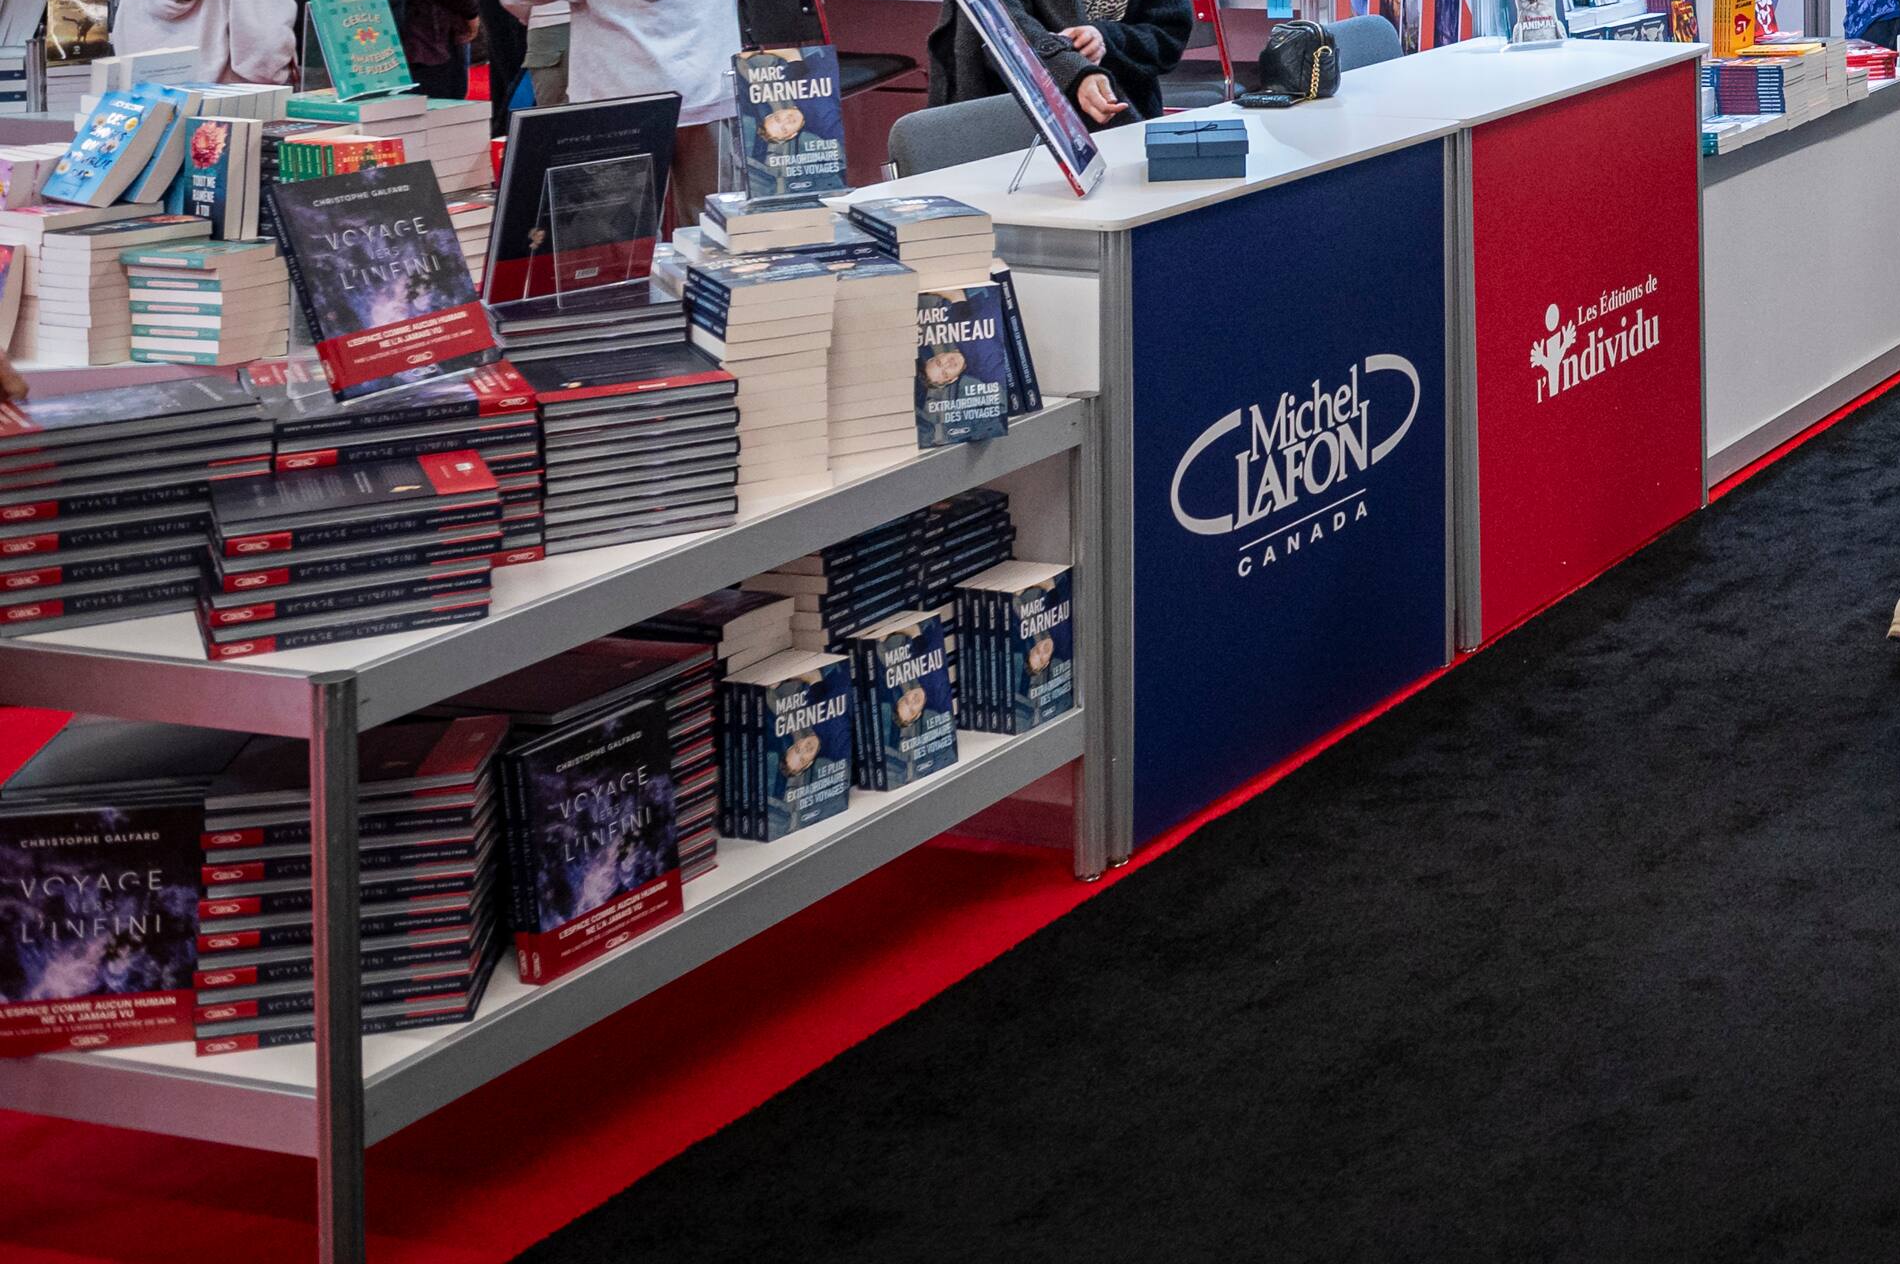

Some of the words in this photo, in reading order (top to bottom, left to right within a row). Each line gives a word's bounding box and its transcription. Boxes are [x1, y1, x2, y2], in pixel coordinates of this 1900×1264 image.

[1522, 21, 1556, 30] ANIMAL
[748, 65, 786, 83] MARC
[749, 77, 832, 104] GARNEAU
[804, 141, 816, 152] LE
[817, 138, 838, 150] PLUS
[769, 150, 840, 167] EXTRAORDINAIRE
[785, 165, 803, 177] DES
[804, 161, 840, 175] VOYAGES
[192, 175, 206, 187] TOUT
[206, 176, 216, 189] ME
[313, 192, 370, 207] CHRISTOPHE
[371, 184, 410, 198] GALFARD
[325, 216, 430, 250] VOYAGE
[339, 255, 442, 290] L'INFINI
[1577, 305, 1598, 326] Les
[1599, 289, 1643, 317] Éditions
[1645, 273, 1658, 294] de
[347, 330, 382, 348] L'ESPACE
[382, 324, 411, 339] COMME
[411, 318, 436, 333] AUCUN
[436, 310, 468, 326] HUMAIN
[964, 385, 977, 396] LE
[977, 382, 999, 394] PLUS
[928, 394, 1000, 413] EXTRAORDINAIRE
[944, 410, 963, 423] DES
[963, 405, 1000, 420] VOYAGES
[1249, 363, 1360, 463] Michel
[1233, 399, 1370, 530] LAFON
[1237, 501, 1368, 577] CANADA
[1020, 597, 1046, 618] MARC
[1020, 600, 1070, 639] GARNEAU
[885, 644, 912, 667] MARC
[886, 647, 944, 689] GARNEAU
[775, 689, 809, 712] MARC
[775, 693, 848, 738] GARNEAU
[926, 718, 936, 730] LE
[556, 747, 607, 773] CHRISTOPHE
[607, 731, 642, 752] GALFARD
[817, 768, 828, 779] LE
[828, 758, 846, 775] PLUS
[559, 765, 650, 819] VOYAGE
[787, 770, 846, 803] EXTRAORDINAIRE
[799, 795, 814, 812] DES
[814, 784, 846, 805] VOYAGES
[20, 836, 99, 848] CHRISTOPHE
[104, 832, 160, 843] GALFARD
[564, 805, 652, 862] L'INFINI
[20, 870, 163, 899] VOYAGE
[21, 914, 162, 943] L'INFINI
[41, 1014, 57, 1025] NE
[77, 1011, 118, 1022] JAMAIS
[119, 1008, 135, 1018] VU
[51, 1001, 92, 1014] COMME
[95, 999, 133, 1011] AUCUN
[134, 996, 176, 1008] HUMAIN
